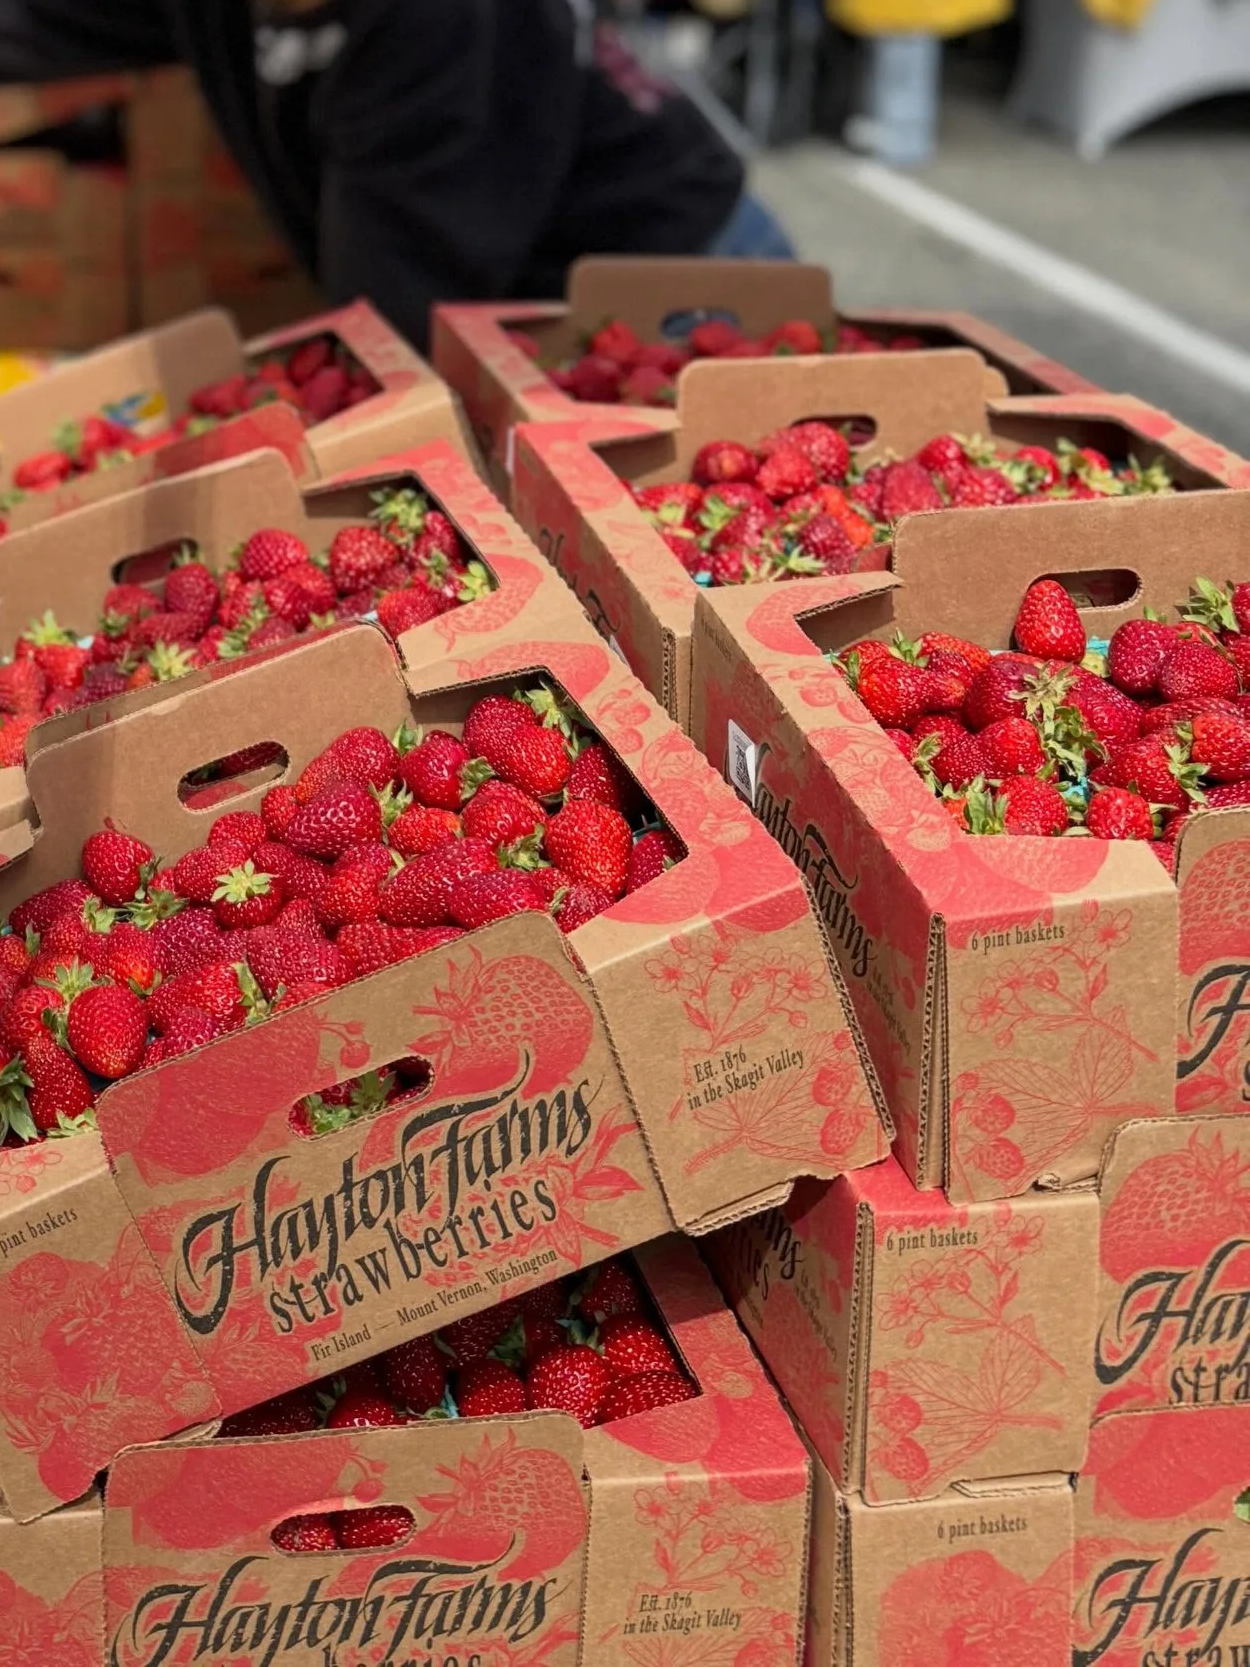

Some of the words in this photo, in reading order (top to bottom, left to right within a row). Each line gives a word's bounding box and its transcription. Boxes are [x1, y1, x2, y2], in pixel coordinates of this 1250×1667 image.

[971, 930, 978, 951] 6
[984, 929, 1010, 955] pint
[1015, 922, 1065, 944] baskets
[686, 1092, 702, 1110] in
[703, 1083, 722, 1104] the
[724, 1063, 765, 1094] Skagit
[766, 1048, 804, 1075] Valley
[693, 1060, 718, 1083] Est.
[720, 1044, 746, 1072] 1876
[174, 1150, 434, 1334] Hayton
[401, 1048, 605, 1216] Farms
[26, 1207, 79, 1239] baskets
[886, 1231, 893, 1251] 6
[898, 1230, 925, 1256] pint
[930, 1226, 978, 1247] baskets
[269, 1178, 558, 1333] strawberries
[310, 1341, 331, 1361] Fir
[332, 1324, 371, 1353] Island
[396, 1297, 438, 1326] Mount
[437, 1280, 487, 1307] Vernon,
[485, 1249, 558, 1286] Washington
[937, 1520, 944, 1539] 6
[948, 1519, 976, 1544] pint
[979, 1514, 1028, 1535] baskets
[111, 1555, 387, 1667] Hayton
[363, 1530, 574, 1659] Farms
[665, 1591, 692, 1614] 1876
[623, 1617, 636, 1634] in
[639, 1615, 658, 1633] the
[662, 1611, 701, 1635] Skagit
[706, 1608, 741, 1631] Valley
